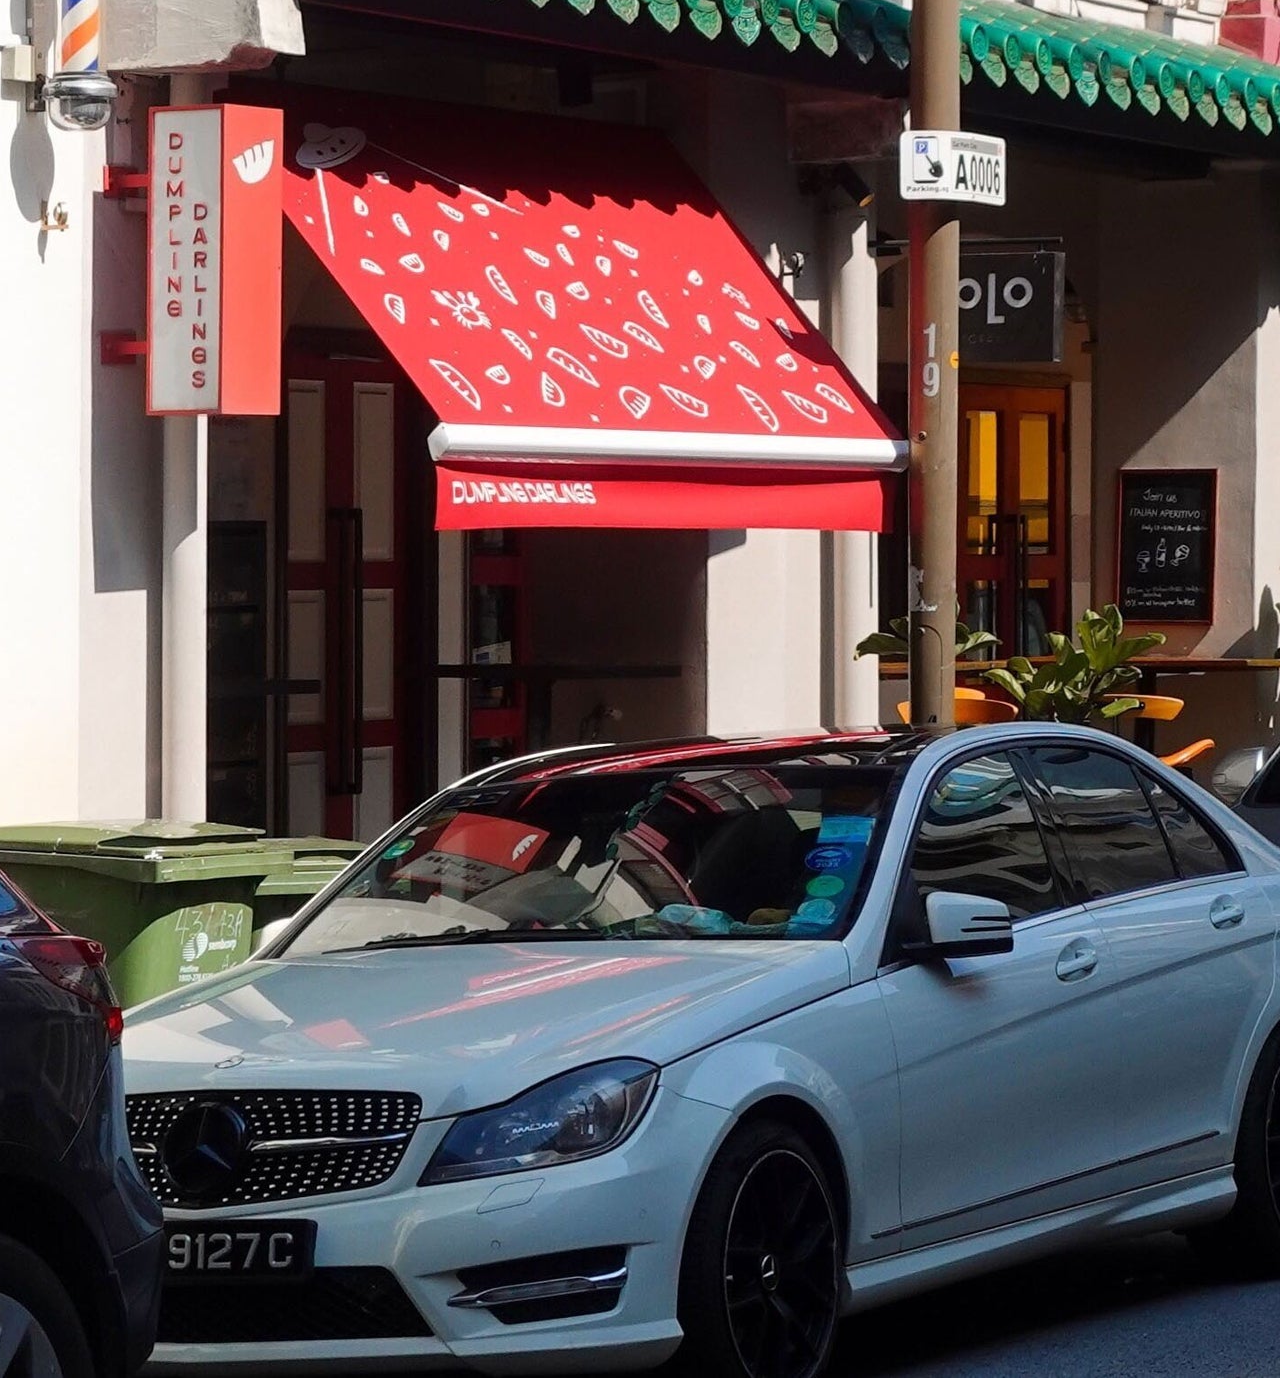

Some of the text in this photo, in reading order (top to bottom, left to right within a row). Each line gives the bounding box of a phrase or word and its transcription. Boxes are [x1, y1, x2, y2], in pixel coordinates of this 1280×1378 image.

[955, 154, 1001, 195] A0006
[166, 133, 186, 318] DUMPLING
[192, 203, 208, 390] DARLINGS
[1129, 507, 1201, 519] ITALIAN APERITIVO
[168, 1232, 294, 1270] 9127 C
